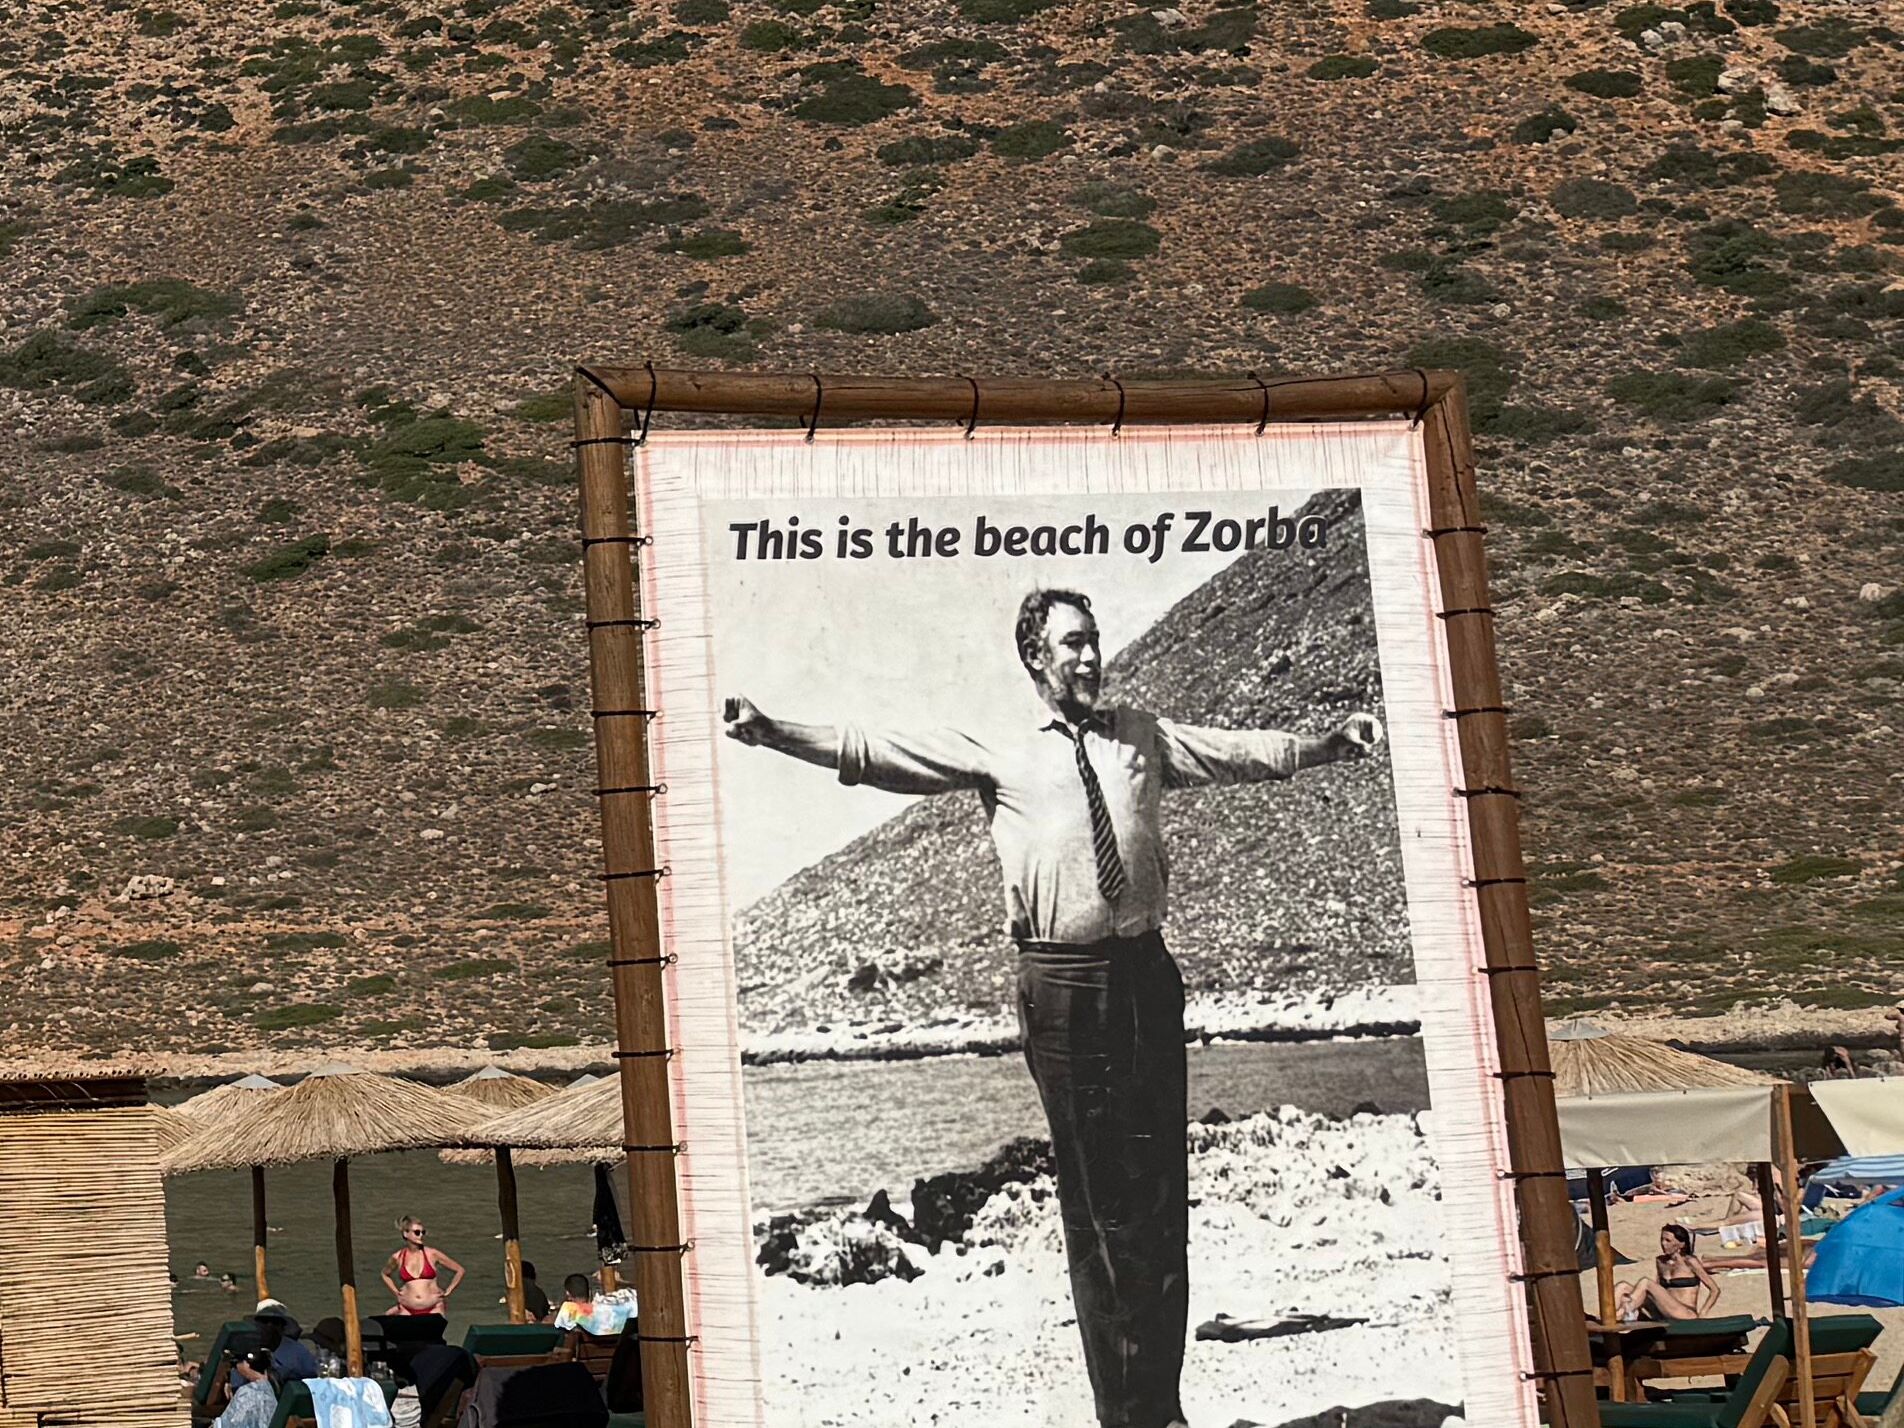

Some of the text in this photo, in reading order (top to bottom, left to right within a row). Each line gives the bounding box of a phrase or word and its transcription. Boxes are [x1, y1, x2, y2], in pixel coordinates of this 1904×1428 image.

[729, 505, 1328, 564] This is the beach of Zorba
